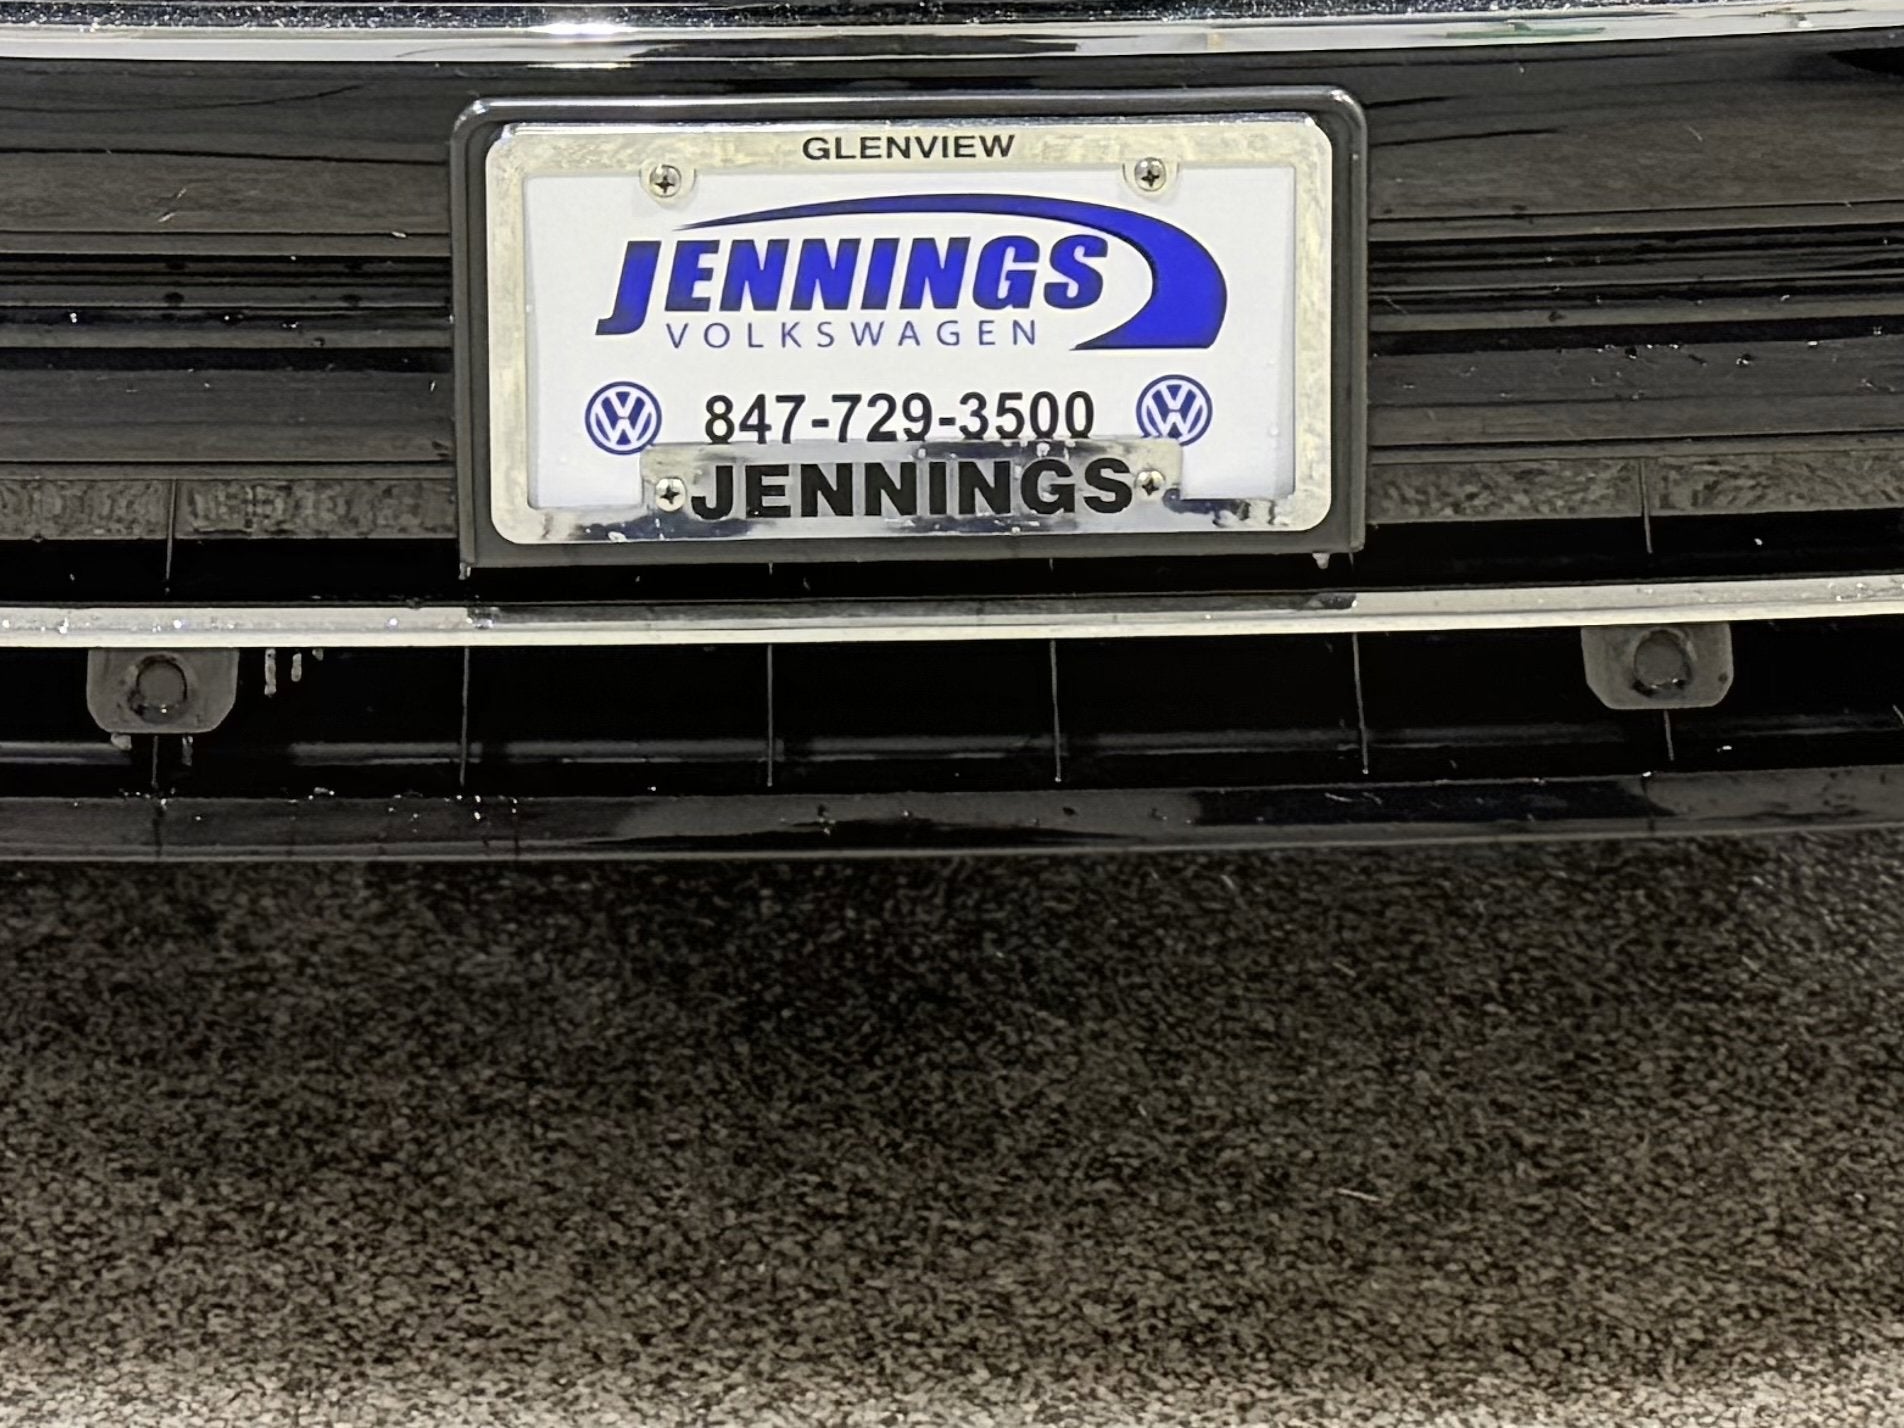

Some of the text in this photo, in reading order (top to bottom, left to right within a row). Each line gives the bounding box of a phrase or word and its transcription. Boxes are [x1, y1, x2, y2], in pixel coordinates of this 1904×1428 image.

[802, 134, 1015, 161] GLENVIEW
[595, 234, 1108, 336] JENNINGS
[666, 319, 1036, 349] VOLKSWAGEN
[705, 390, 1094, 445] 847-729-3500
[690, 457, 1133, 521] JENNINGS
